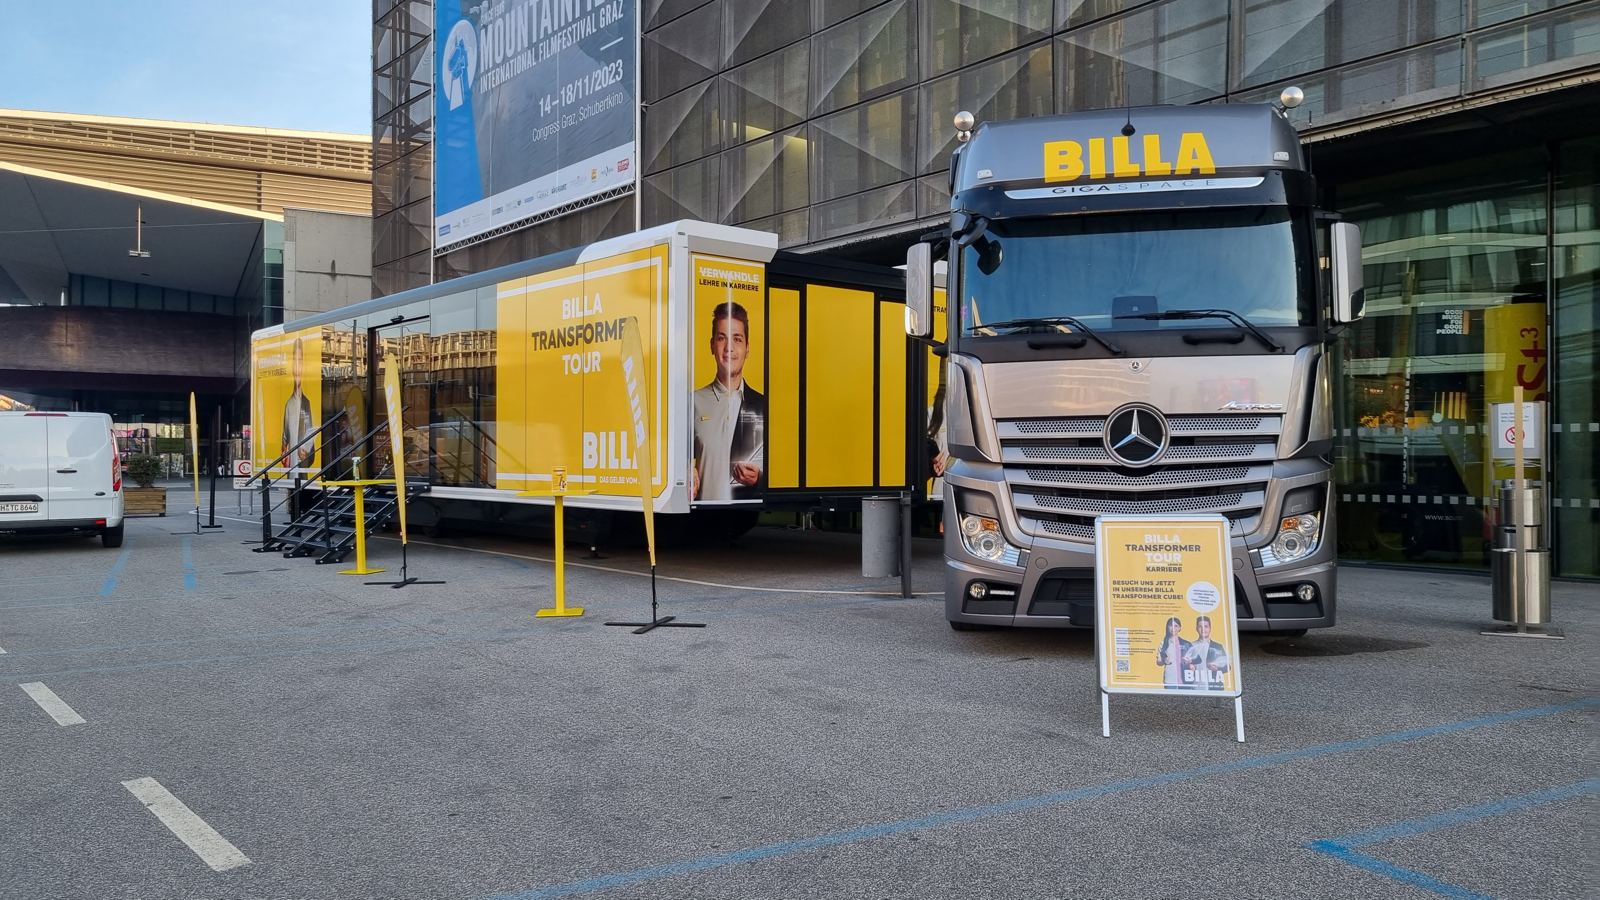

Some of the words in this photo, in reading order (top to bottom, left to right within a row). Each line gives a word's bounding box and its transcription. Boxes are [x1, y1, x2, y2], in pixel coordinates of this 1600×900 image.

[480, 0, 605, 74] MOUNTAIN
[480, 47, 537, 94] INTERNATIONAL
[538, 13, 597, 63] FILMFESTIVAL
[599, 0, 624, 28] GRAZ
[532, 120, 560, 142] Congress
[561, 113, 578, 129] Graz,
[579, 91, 624, 121] Schubertkino
[1042, 131, 1217, 184] BILLA
[699, 266, 760, 284] VERWANDLE
[699, 279, 720, 287] LEHRE
[729, 282, 760, 292] KARRIERE
[562, 293, 603, 320] BILLA
[562, 351, 601, 376] TOUR
[1125, 544, 1201, 552] TRANSFORMER
[1144, 534, 1181, 543] BILLA
[1145, 553, 1183, 562] TOUR
[1184, 669, 1225, 683] BILLA
